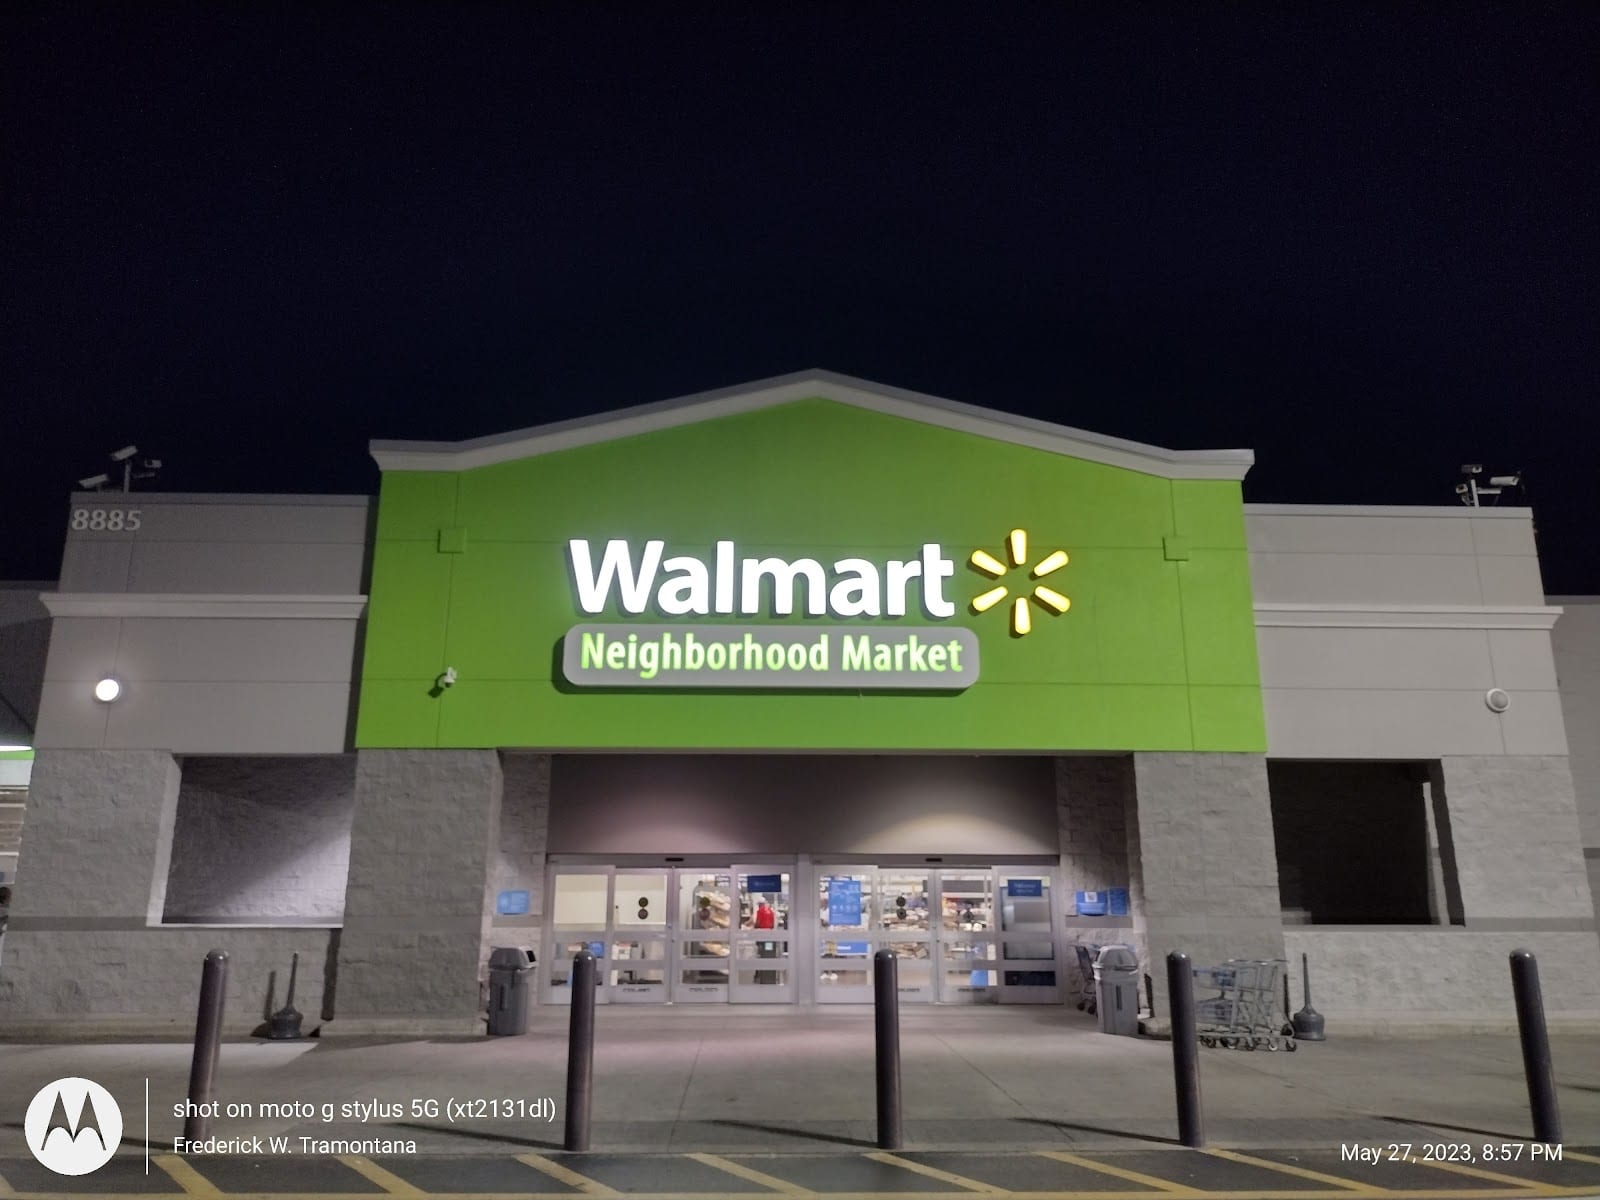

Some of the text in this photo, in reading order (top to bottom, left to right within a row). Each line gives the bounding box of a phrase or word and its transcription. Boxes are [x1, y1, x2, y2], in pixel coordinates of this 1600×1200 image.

[71, 508, 142, 531] 8885
[569, 539, 955, 618] Walmart
[580, 632, 964, 679] Neighborhood Market
